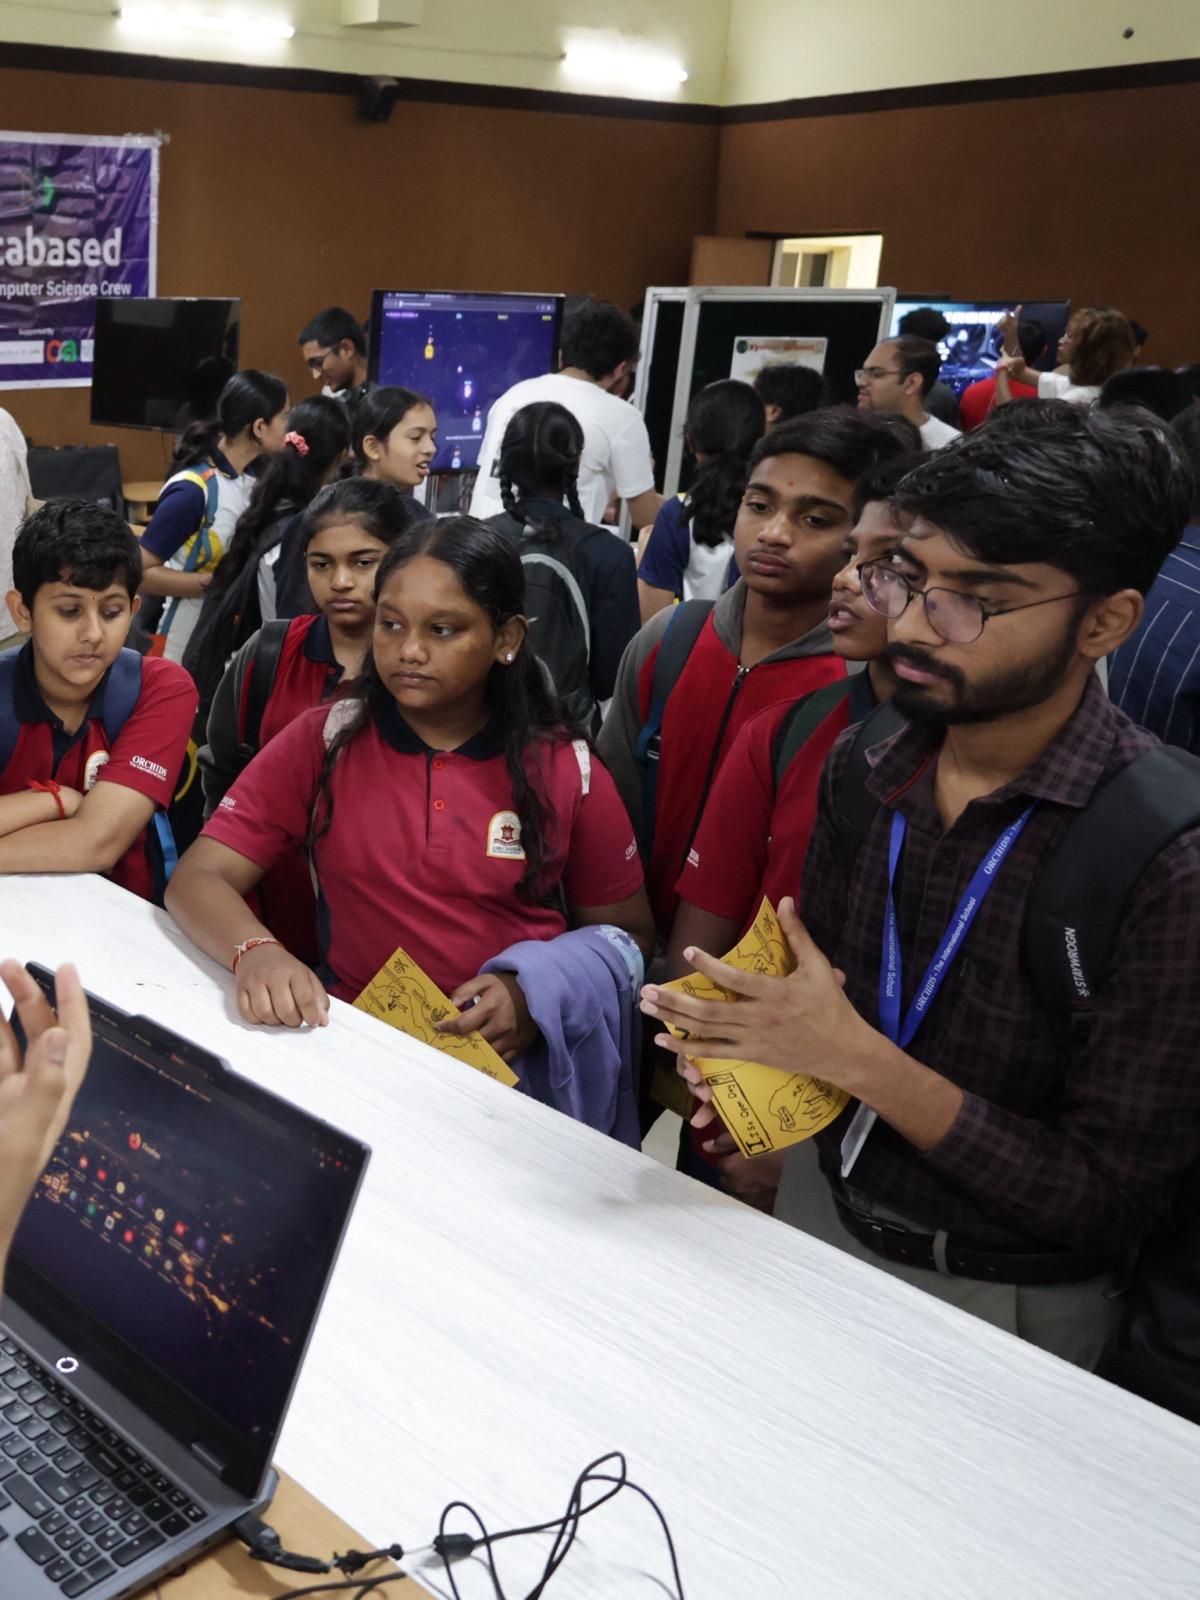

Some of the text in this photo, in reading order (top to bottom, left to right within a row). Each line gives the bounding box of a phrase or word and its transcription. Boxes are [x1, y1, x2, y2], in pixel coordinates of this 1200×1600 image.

[46, 281, 98, 296] Science
[101, 281, 132, 295] Crew
[132, 755, 168, 777] ORCHIDS
[983, 835, 1011, 875] ORCHIDS
[915, 976, 937, 1011] ORCHIDS
[934, 960, 945, 972] The
[940, 920, 965, 961] International
[960, 896, 976, 921] School
[1064, 927, 1087, 988] STAYWROGN
[886, 971, 896, 997] School
